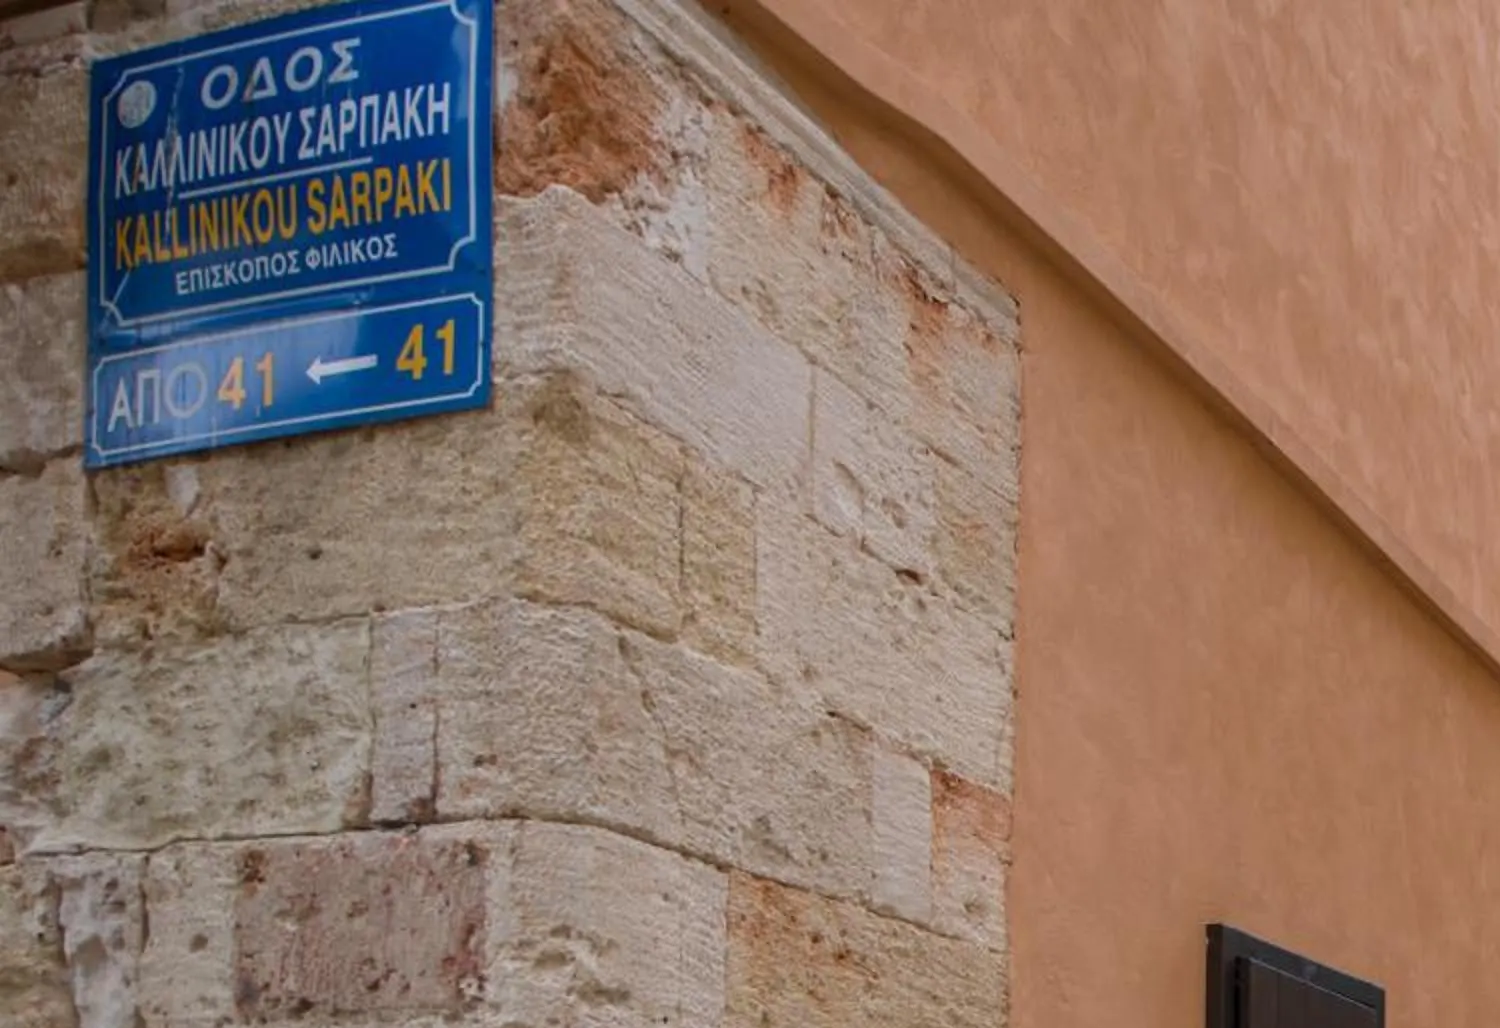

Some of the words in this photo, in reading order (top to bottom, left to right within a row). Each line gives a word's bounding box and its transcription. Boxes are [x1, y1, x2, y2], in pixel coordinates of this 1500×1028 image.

[200, 37, 361, 109] ΟΔΟΣ
[115, 111, 292, 199] ΚΑΛΛΙΝΙΚΟΥ
[299, 82, 451, 161] ΣΑΡΠΑΚΗ
[115, 184, 298, 271] KALLINIKOU
[307, 158, 452, 234] SARPAKI
[175, 249, 300, 296] ΕΠΙΣΚΟΠΟΣ
[305, 232, 398, 271] ΦΙΛΙΚΟΣ
[107, 362, 207, 432] ΑΠΟ
[217, 351, 274, 411] 41
[396, 319, 456, 380] 41
